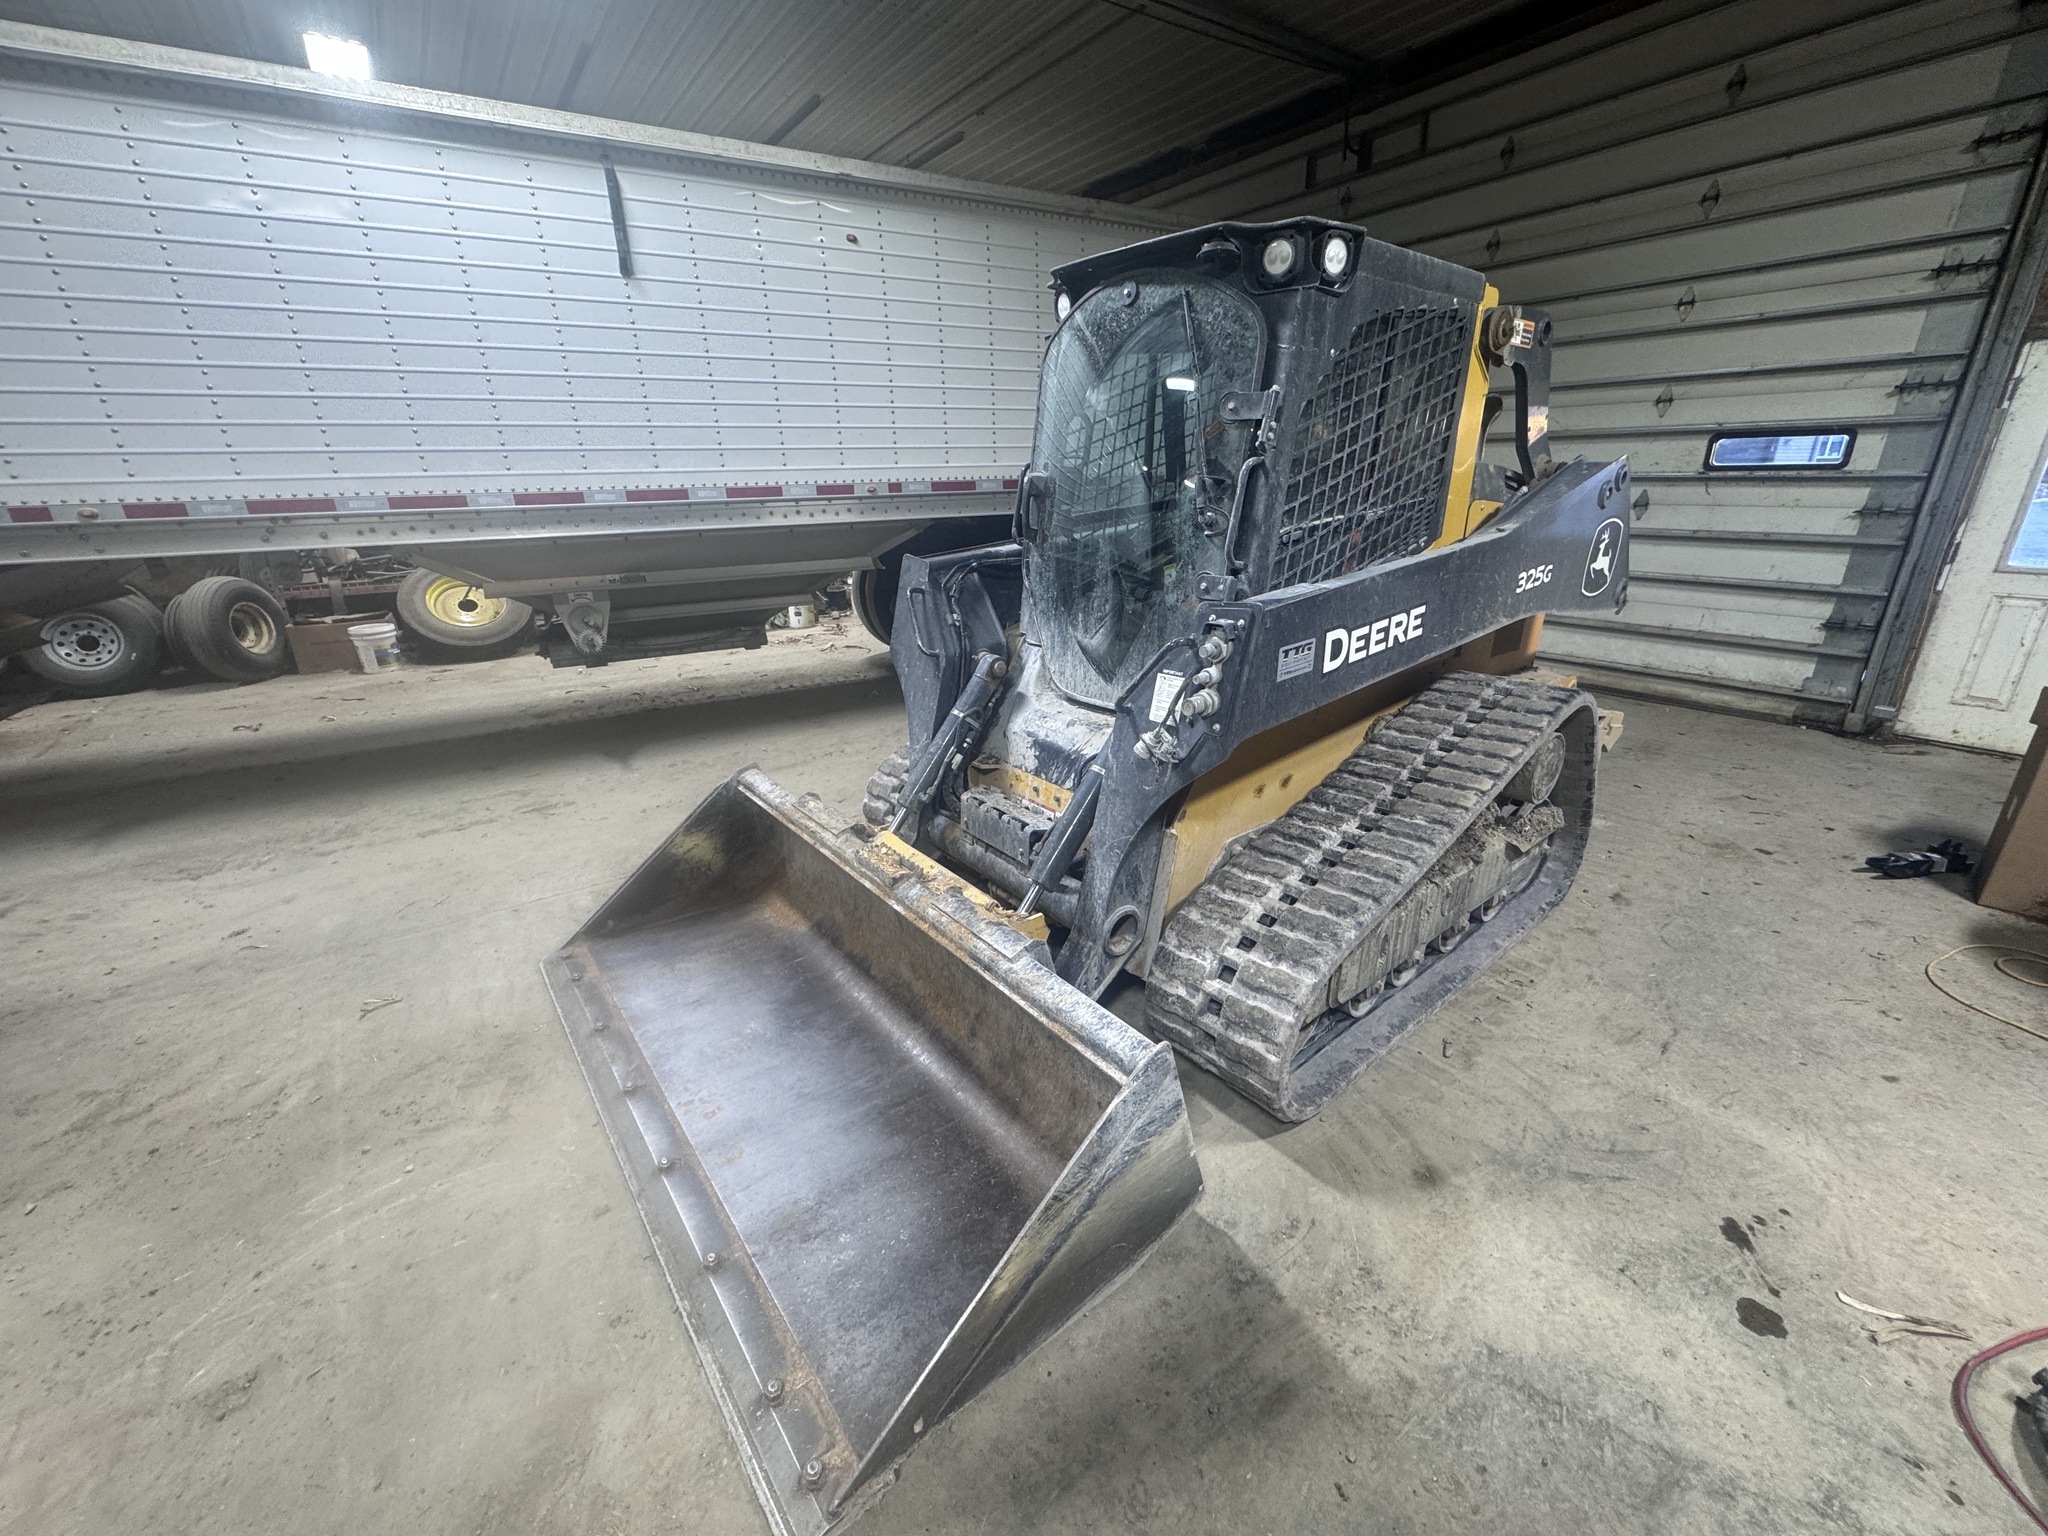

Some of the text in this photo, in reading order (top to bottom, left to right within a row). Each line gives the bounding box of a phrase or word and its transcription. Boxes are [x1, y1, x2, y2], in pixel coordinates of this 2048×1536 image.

[1515, 564, 1553, 594] 325G
[1281, 641, 1313, 662] TTG
[1323, 604, 1427, 674] DEERE
